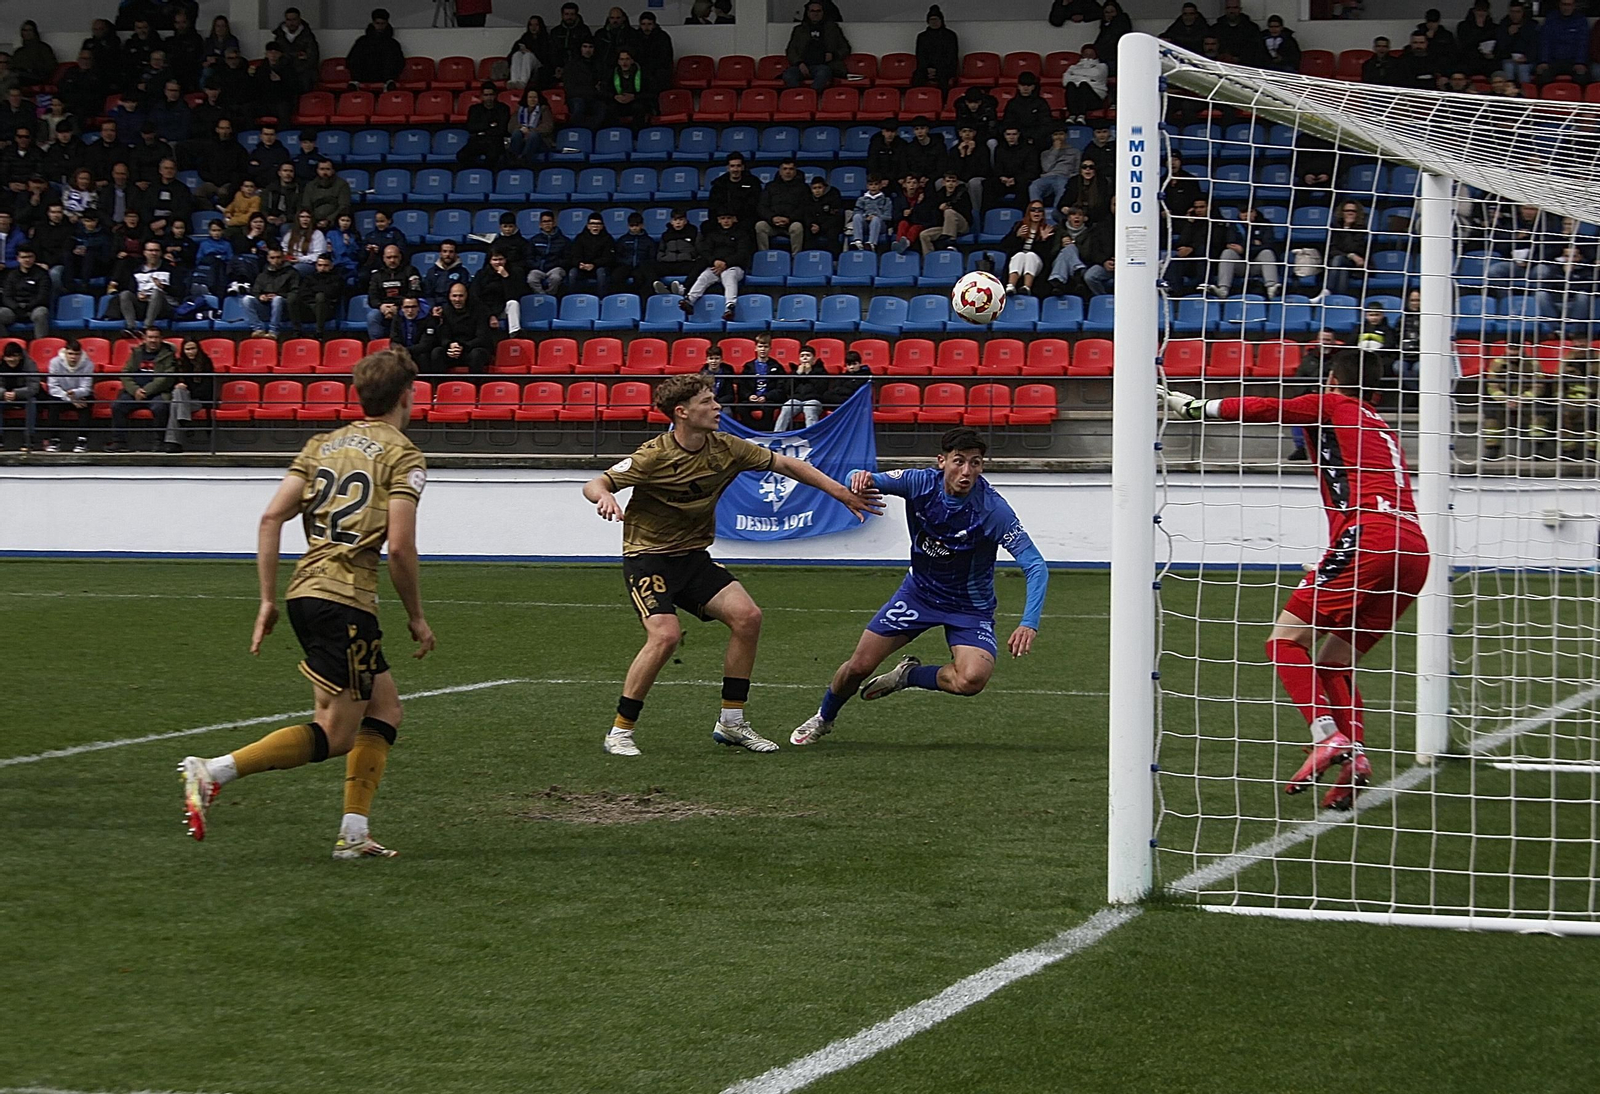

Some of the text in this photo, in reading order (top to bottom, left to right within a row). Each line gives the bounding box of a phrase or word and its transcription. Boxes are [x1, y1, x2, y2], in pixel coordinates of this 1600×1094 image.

[1129, 140, 1145, 214] MONDO
[303, 466, 374, 547] 22
[735, 510, 814, 531] DESDE 1977
[638, 574, 667, 597] 28
[885, 600, 919, 628] 22
